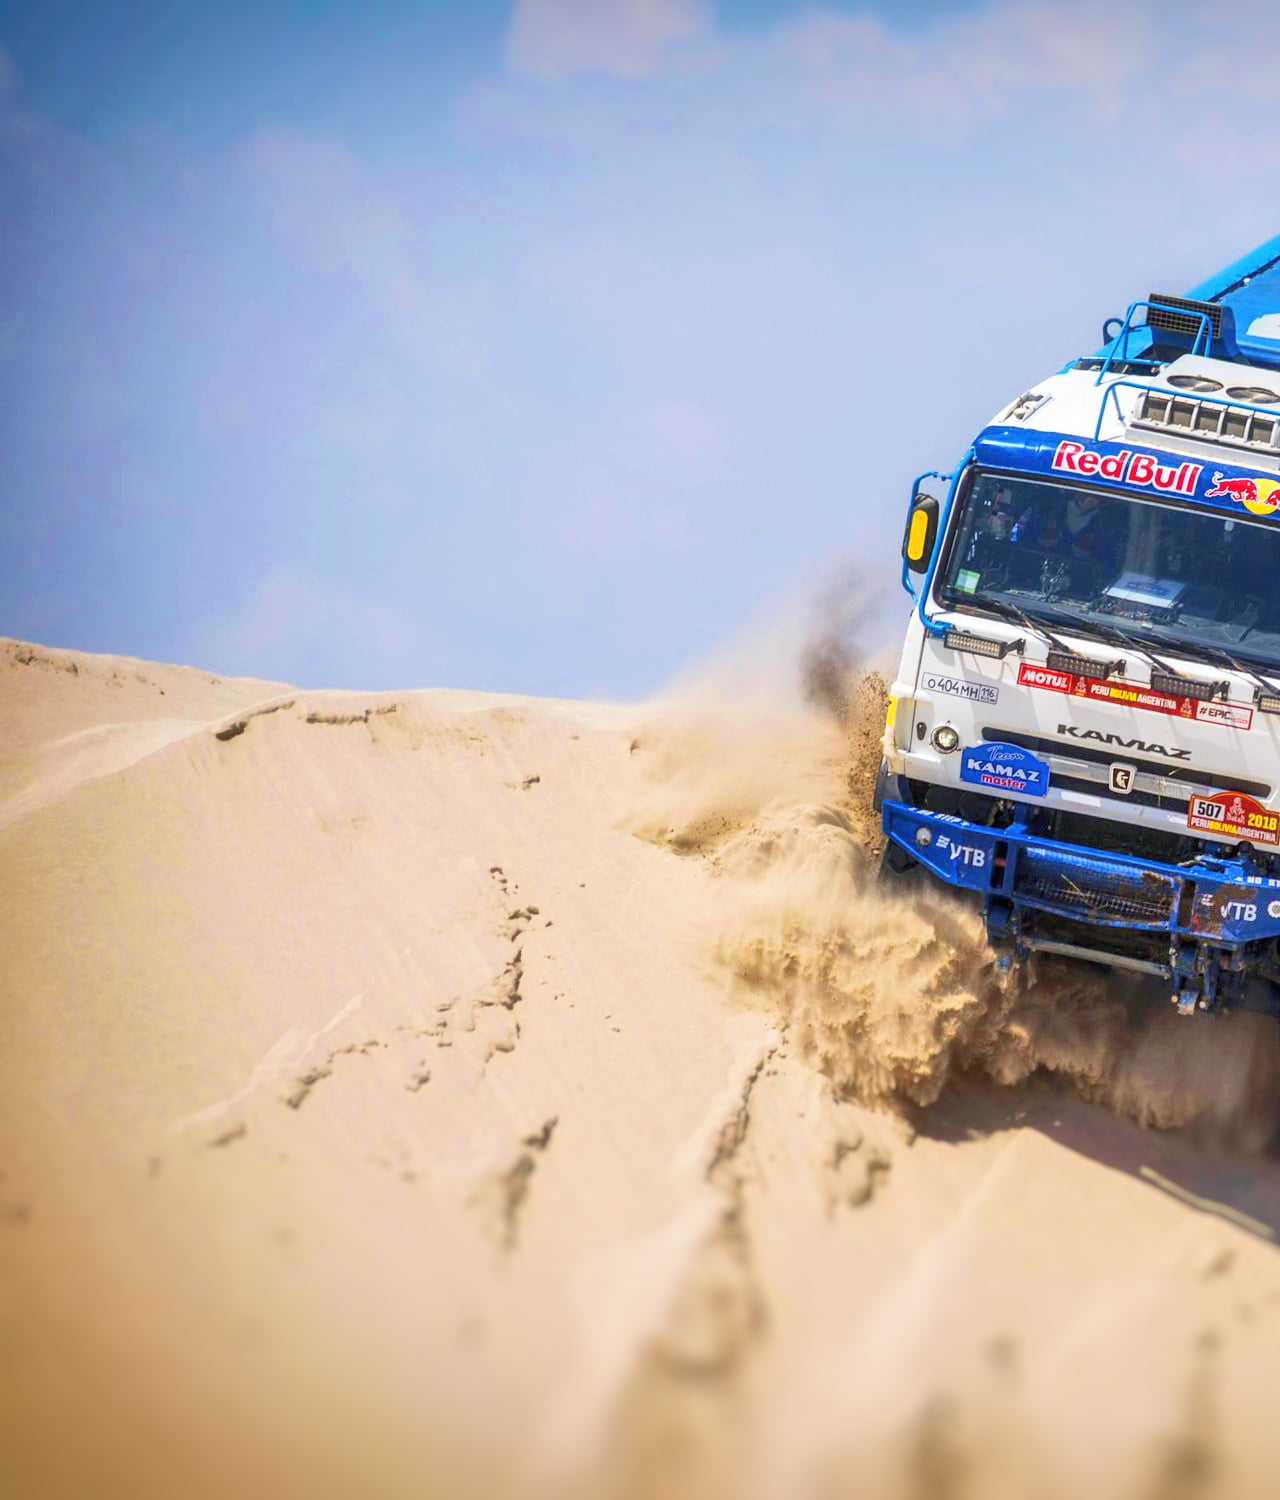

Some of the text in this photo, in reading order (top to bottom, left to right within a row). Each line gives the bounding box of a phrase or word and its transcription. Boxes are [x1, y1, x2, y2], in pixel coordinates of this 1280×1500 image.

[1051, 440, 1204, 496] Red Bull
[1022, 670, 1068, 688] MOTUL
[1091, 683, 1109, 696] PERU
[1109, 687, 1137, 702] BOLIVIA
[1137, 692, 1177, 710] ARGENTINA
[987, 745, 1025, 762] Team
[1057, 724, 1192, 761] KAMAZ
[967, 759, 1040, 782] KAMAZ
[981, 774, 1026, 790] master
[1197, 802, 1278, 831] 507 2018
[949, 843, 985, 867] VTB
[1247, 876, 1262, 884] NO
